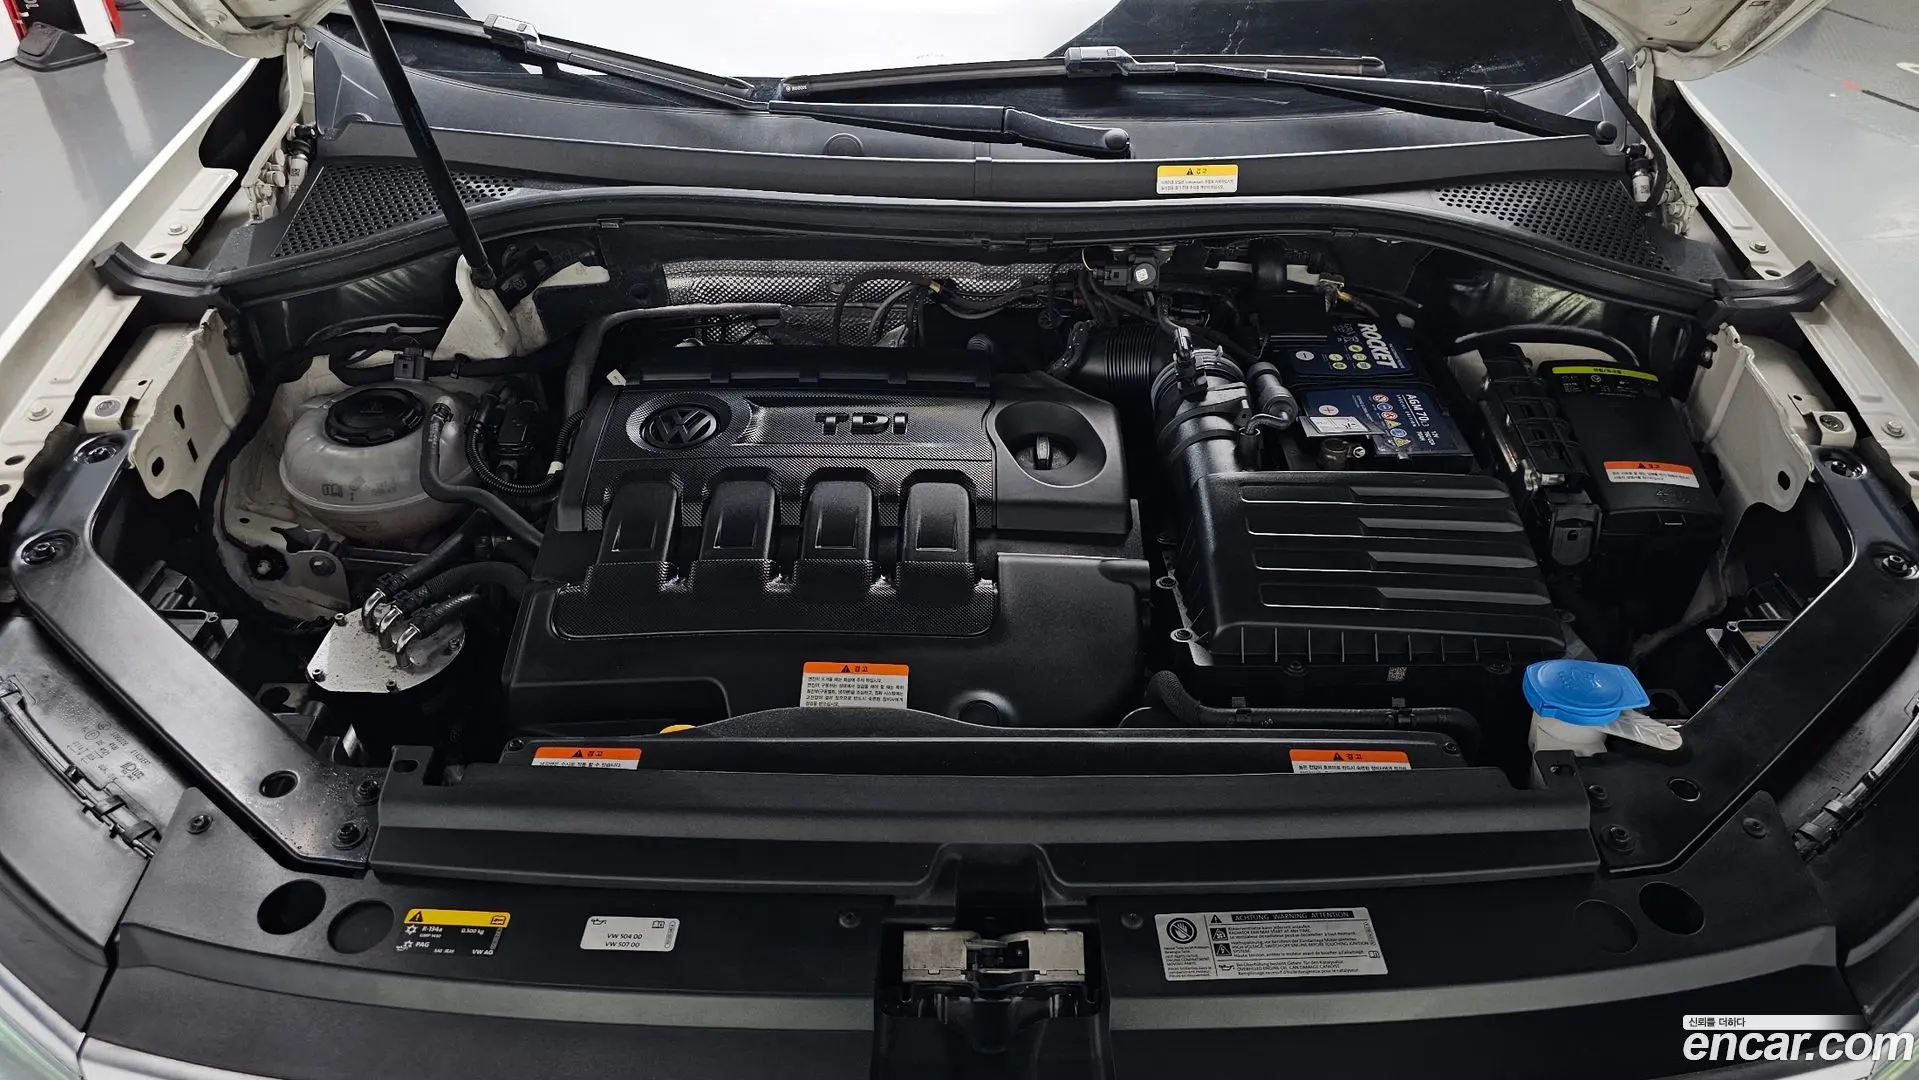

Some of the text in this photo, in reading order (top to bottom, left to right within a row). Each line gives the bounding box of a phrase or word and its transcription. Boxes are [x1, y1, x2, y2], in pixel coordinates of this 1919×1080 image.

[1358, 324, 1398, 368] ROCKET
[1406, 394, 1424, 411] AGM
[815, 412, 908, 434] TDI
